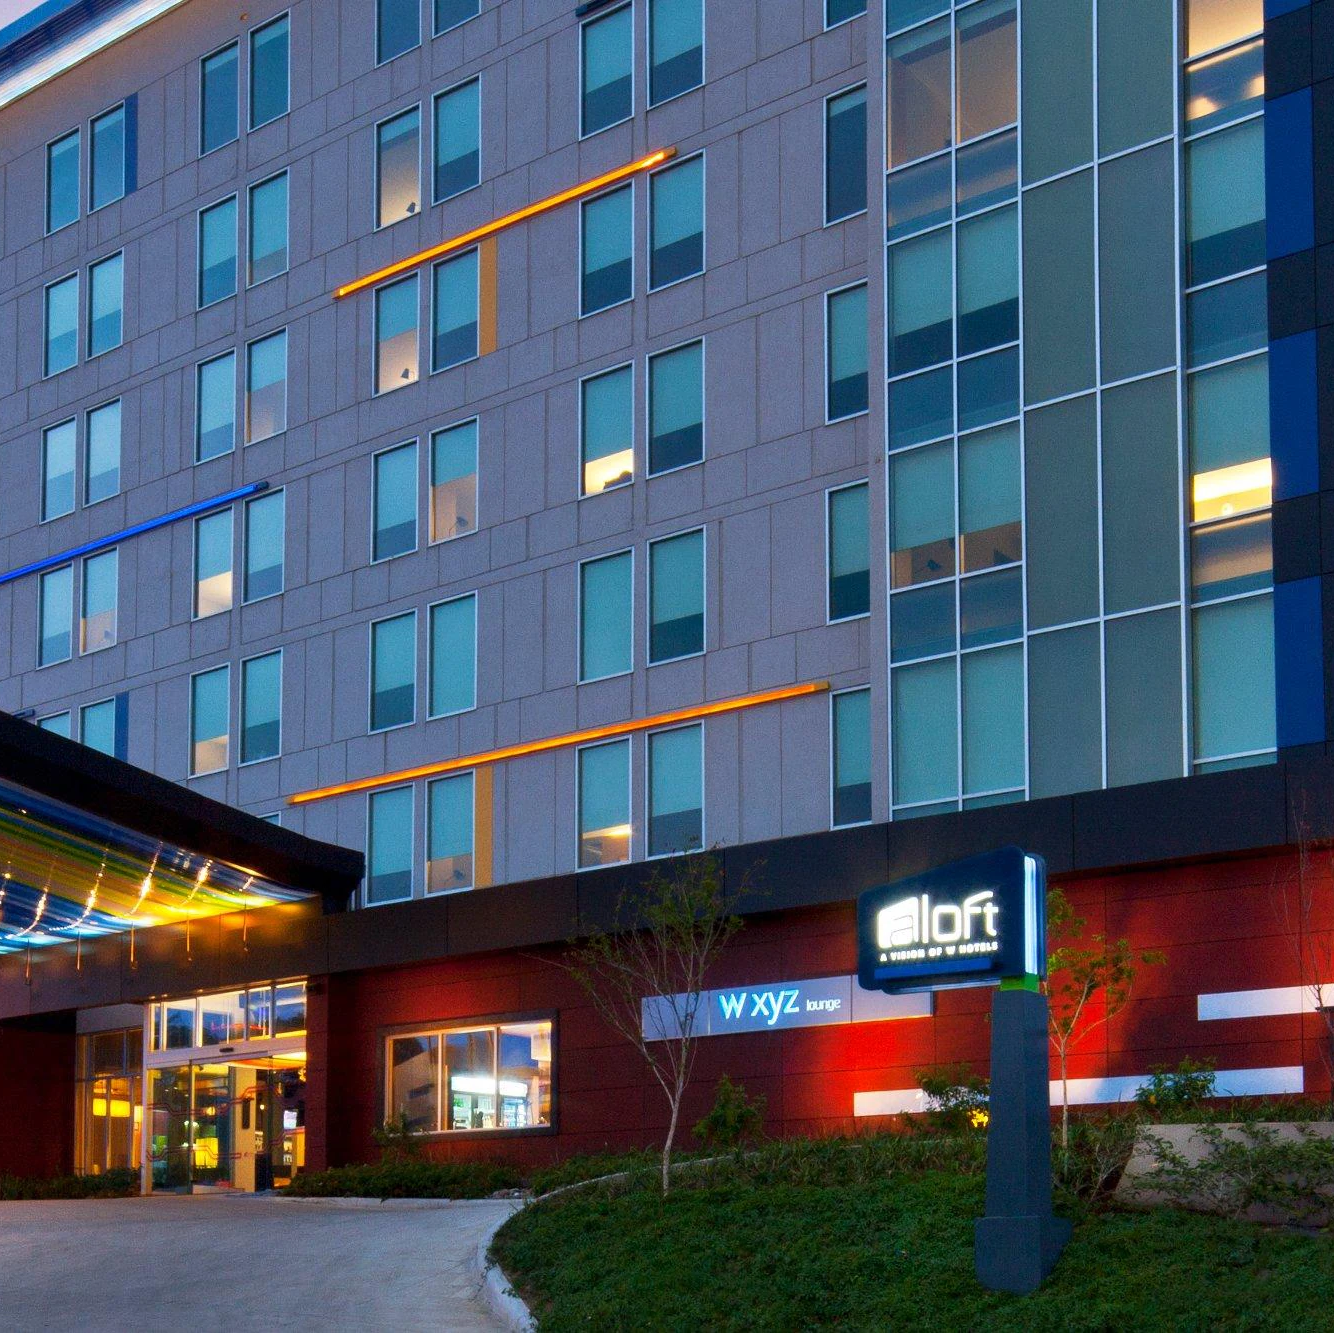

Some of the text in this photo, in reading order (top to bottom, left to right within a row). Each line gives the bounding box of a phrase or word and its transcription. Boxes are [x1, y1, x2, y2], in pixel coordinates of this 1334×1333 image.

[877, 890, 999, 949] aloft
[880, 941, 998, 962] A VISION OF W HOTELS
[750, 989, 800, 1025] xyz
[806, 998, 841, 1012] lounge
